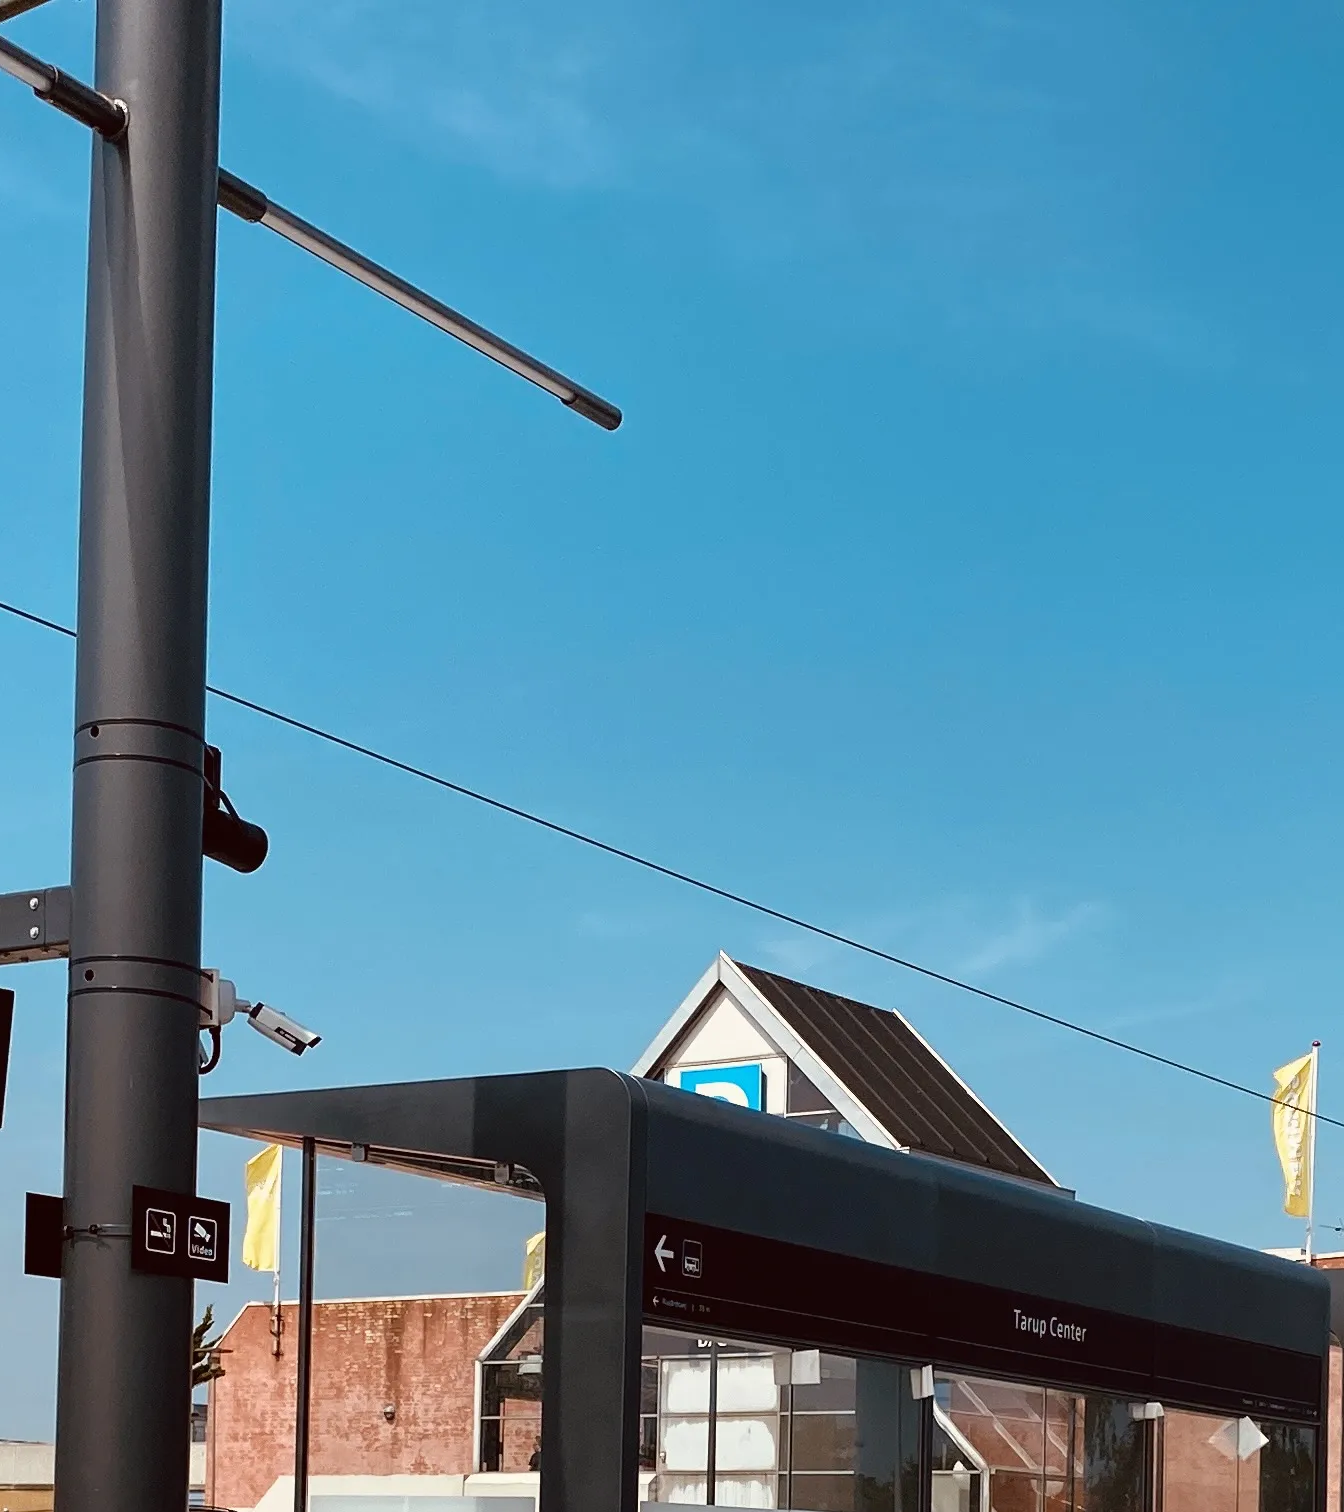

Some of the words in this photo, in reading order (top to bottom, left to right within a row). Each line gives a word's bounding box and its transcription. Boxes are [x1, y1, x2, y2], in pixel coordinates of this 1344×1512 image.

[192, 1244, 213, 1256] Video
[1013, 1308, 1047, 1339] Tarup
[1049, 1316, 1087, 1342] Center
